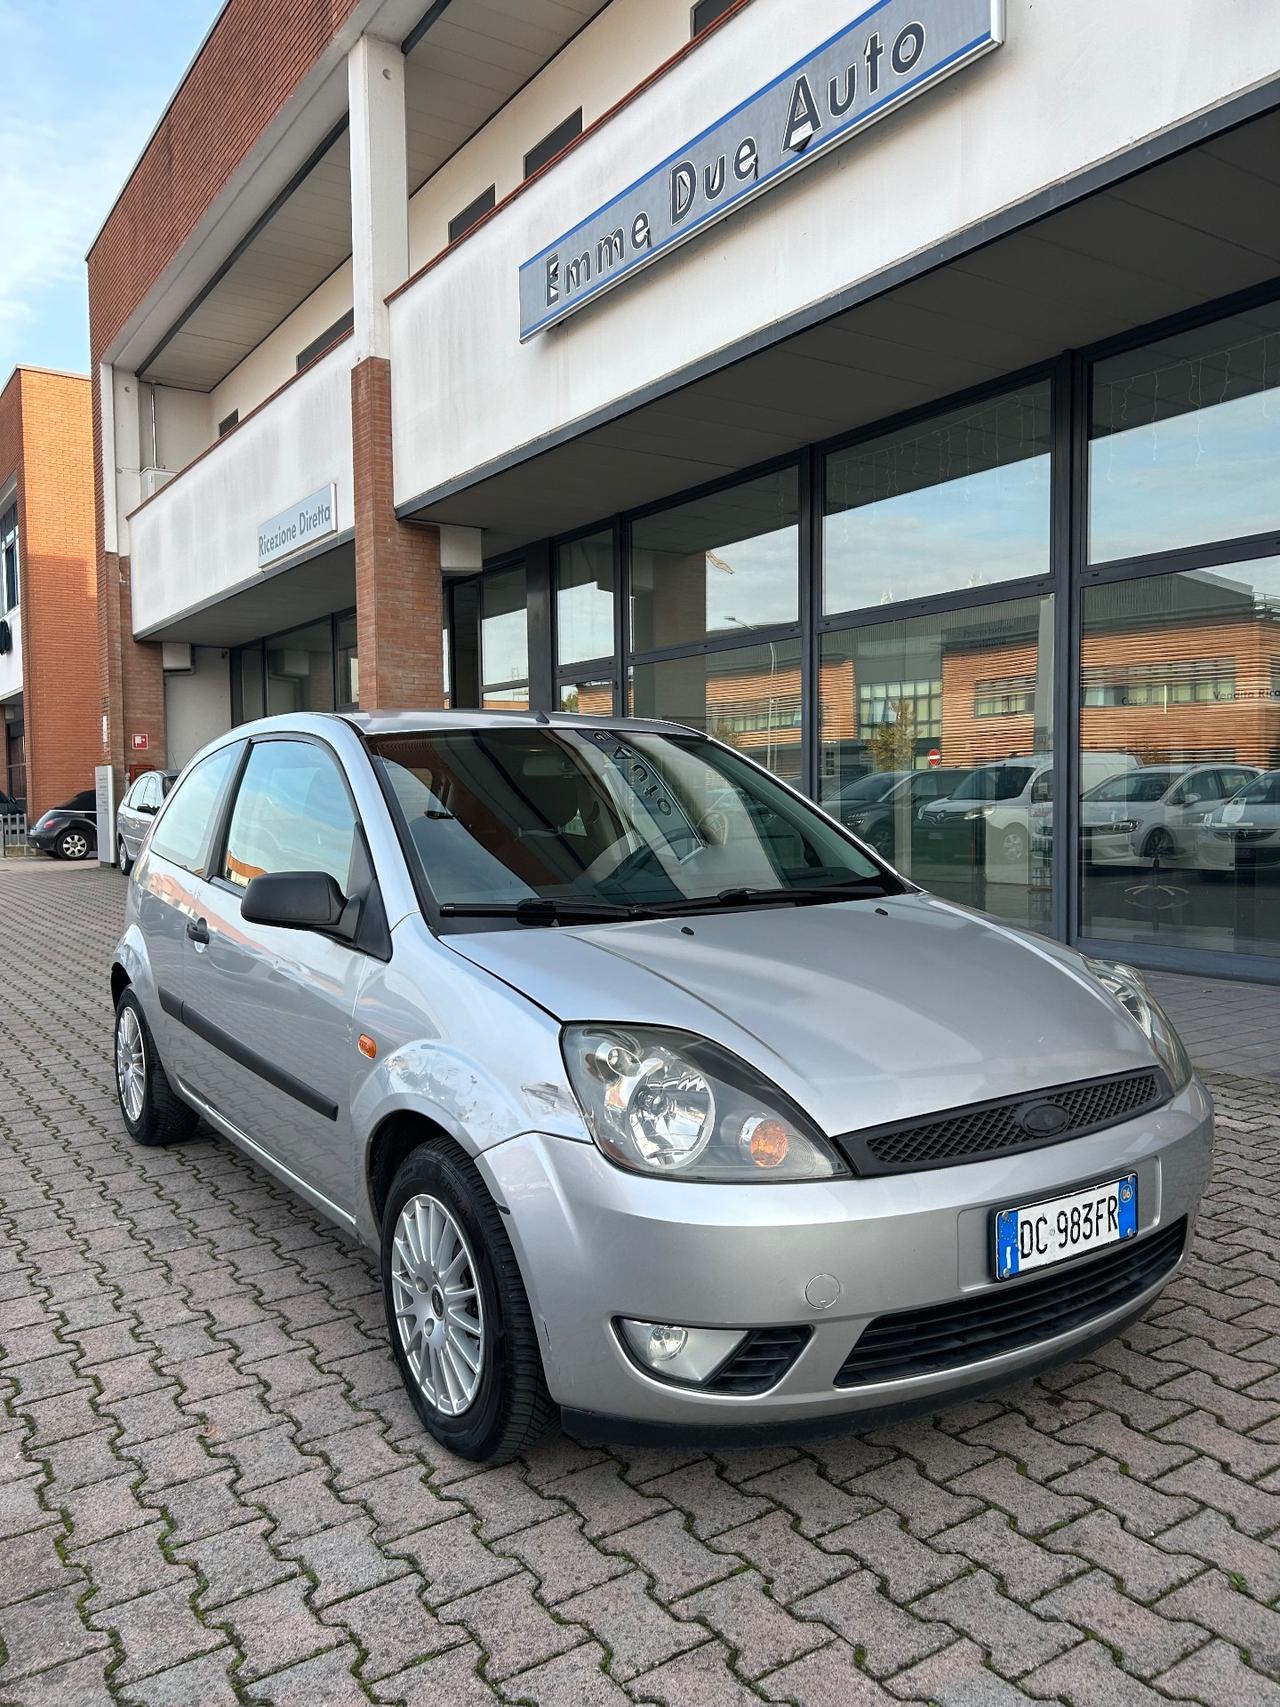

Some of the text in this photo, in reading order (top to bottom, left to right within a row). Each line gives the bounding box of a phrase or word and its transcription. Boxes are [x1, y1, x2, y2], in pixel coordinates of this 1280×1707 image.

[545, 20, 926, 308] Emme Due Auto
[258, 504, 331, 557] Ricezione Diretta
[1020, 1195, 1119, 1260] DC 983FR
